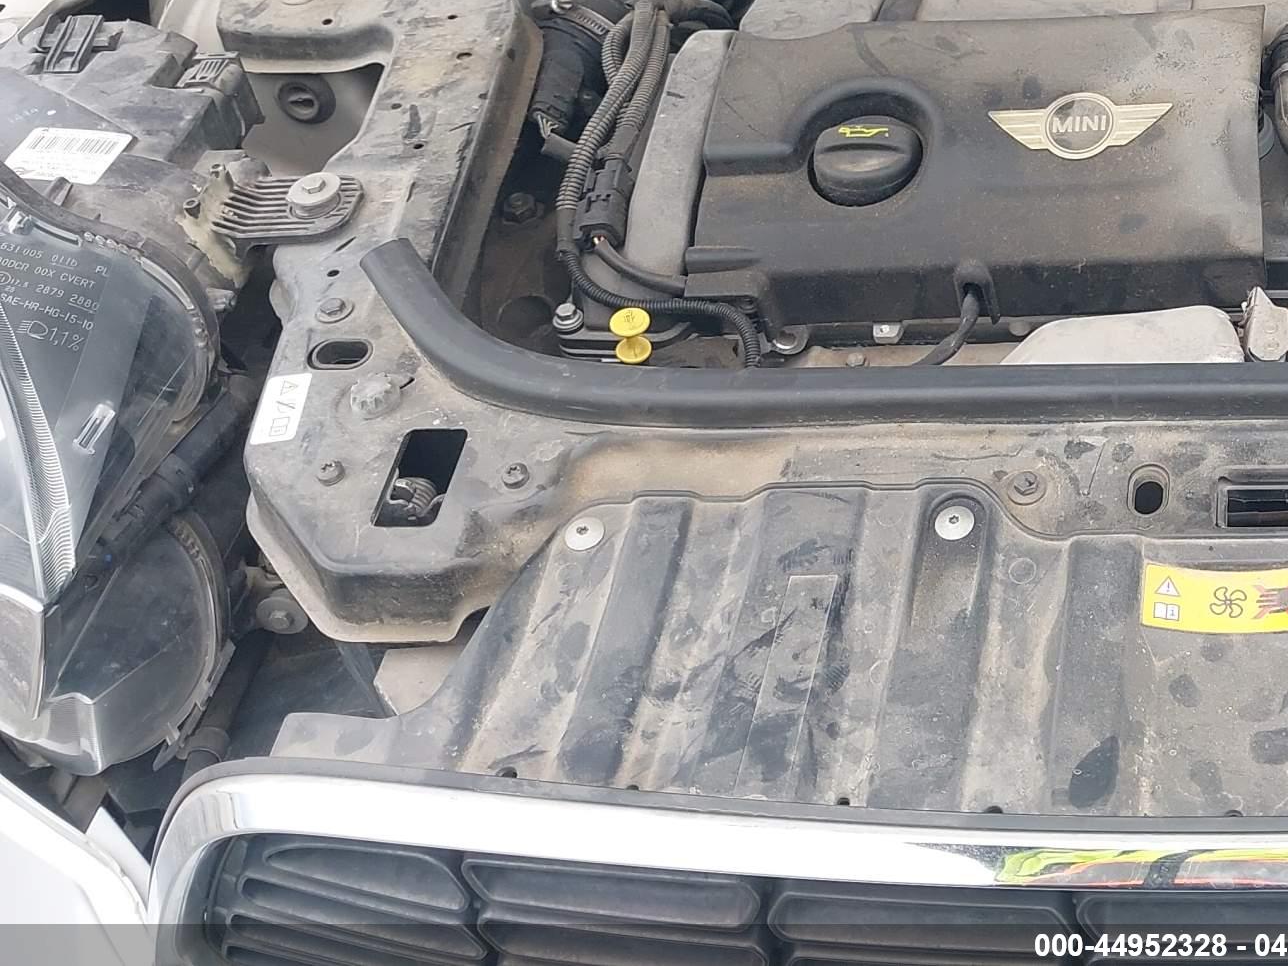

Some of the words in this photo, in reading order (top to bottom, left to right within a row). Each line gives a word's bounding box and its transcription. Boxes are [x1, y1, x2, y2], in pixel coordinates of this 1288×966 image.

[1052, 115, 1106, 133] MINI
[0, 242, 20, 252] 631
[95, 265, 110, 277] PL
[34, 266, 56, 278] 00X
[60, 273, 96, 289] CVERT
[35, 284, 64, 298] 2879
[69, 294, 100, 311] 2880
[49, 326, 85, 352] 1,1%
